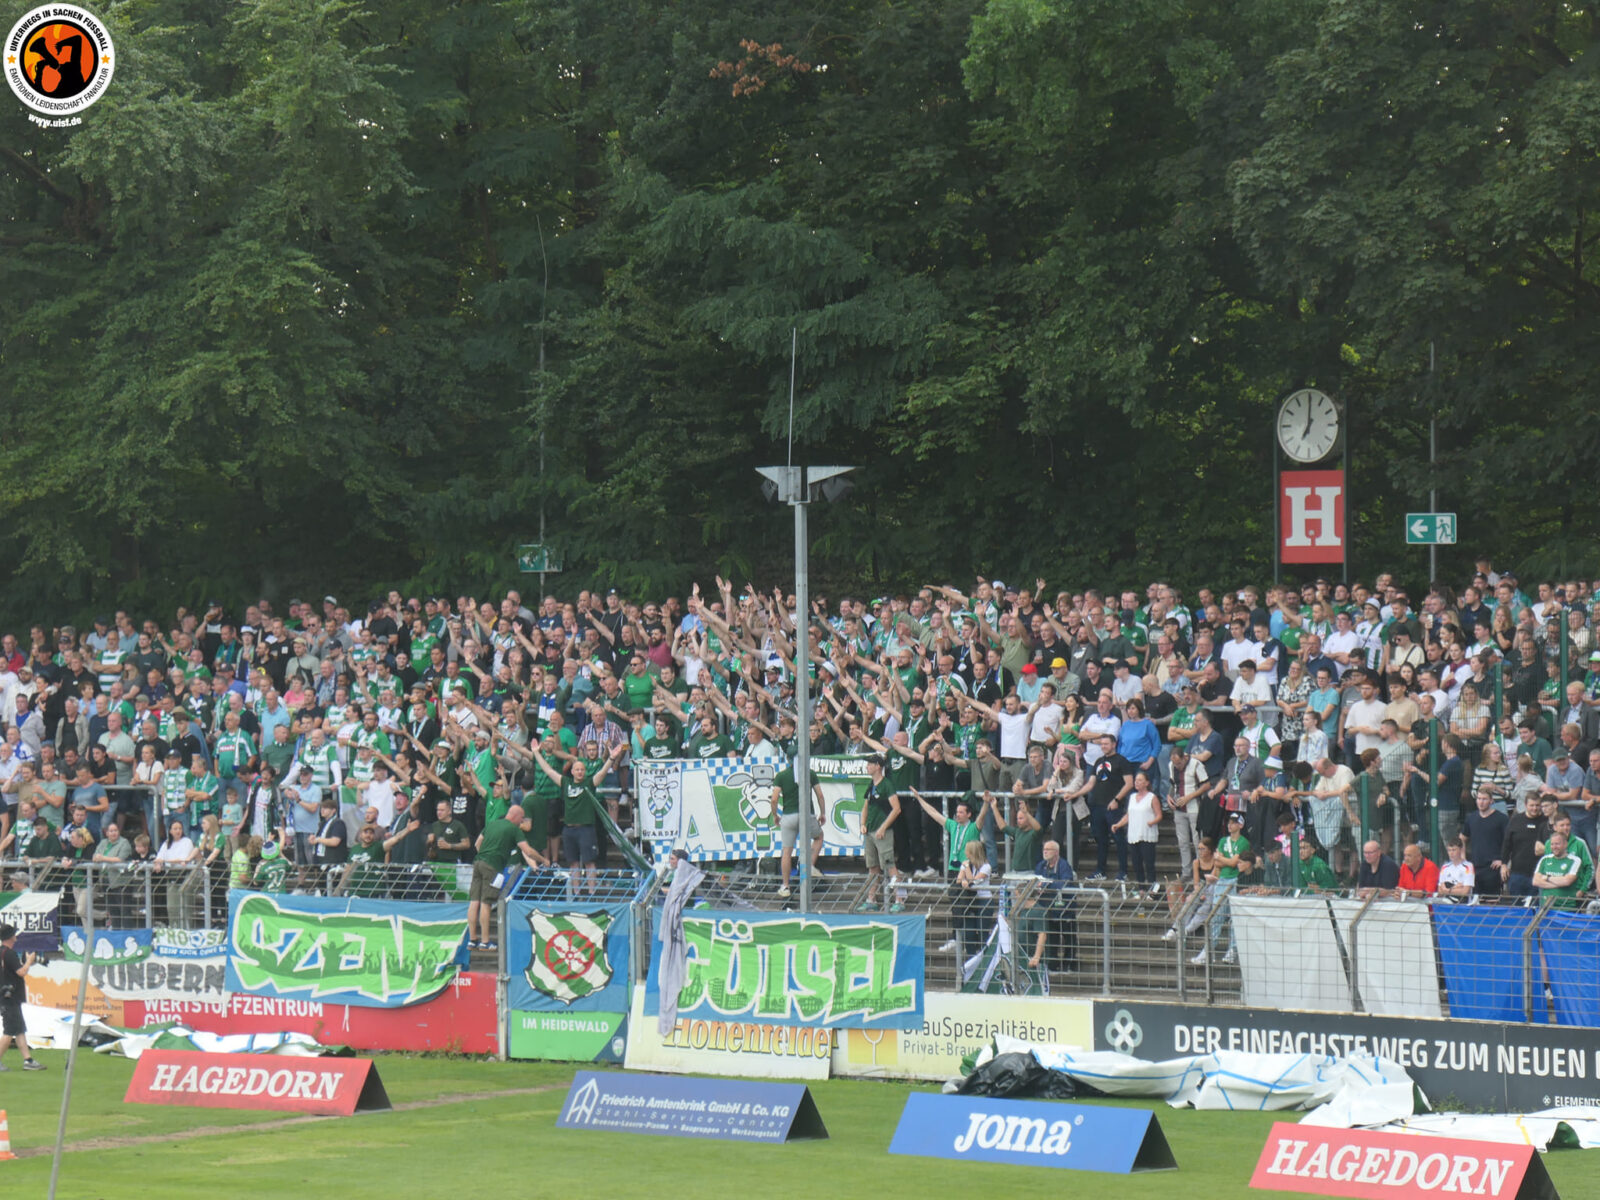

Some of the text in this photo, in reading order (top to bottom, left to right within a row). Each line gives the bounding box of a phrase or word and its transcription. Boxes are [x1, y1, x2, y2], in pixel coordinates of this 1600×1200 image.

[1285, 486, 1341, 546] H
[230, 894, 469, 1004] SZENE
[522, 1017, 609, 1032] IM HEIDEWALD
[903, 1016, 1058, 1042] auSpezialitäten
[1174, 1024, 1222, 1054] DER
[1228, 1028, 1368, 1059] EINFACHSTE
[1373, 1036, 1429, 1068] WEG
[1434, 1039, 1489, 1073] ZUM
[1497, 1043, 1586, 1079] NEUEN
[149, 1064, 344, 1100] HAGEDORN
[600, 1093, 790, 1118] Friedrich Amtenbrink GmbH & Co. KG
[1266, 1138, 1515, 1197] HAGEDORN
